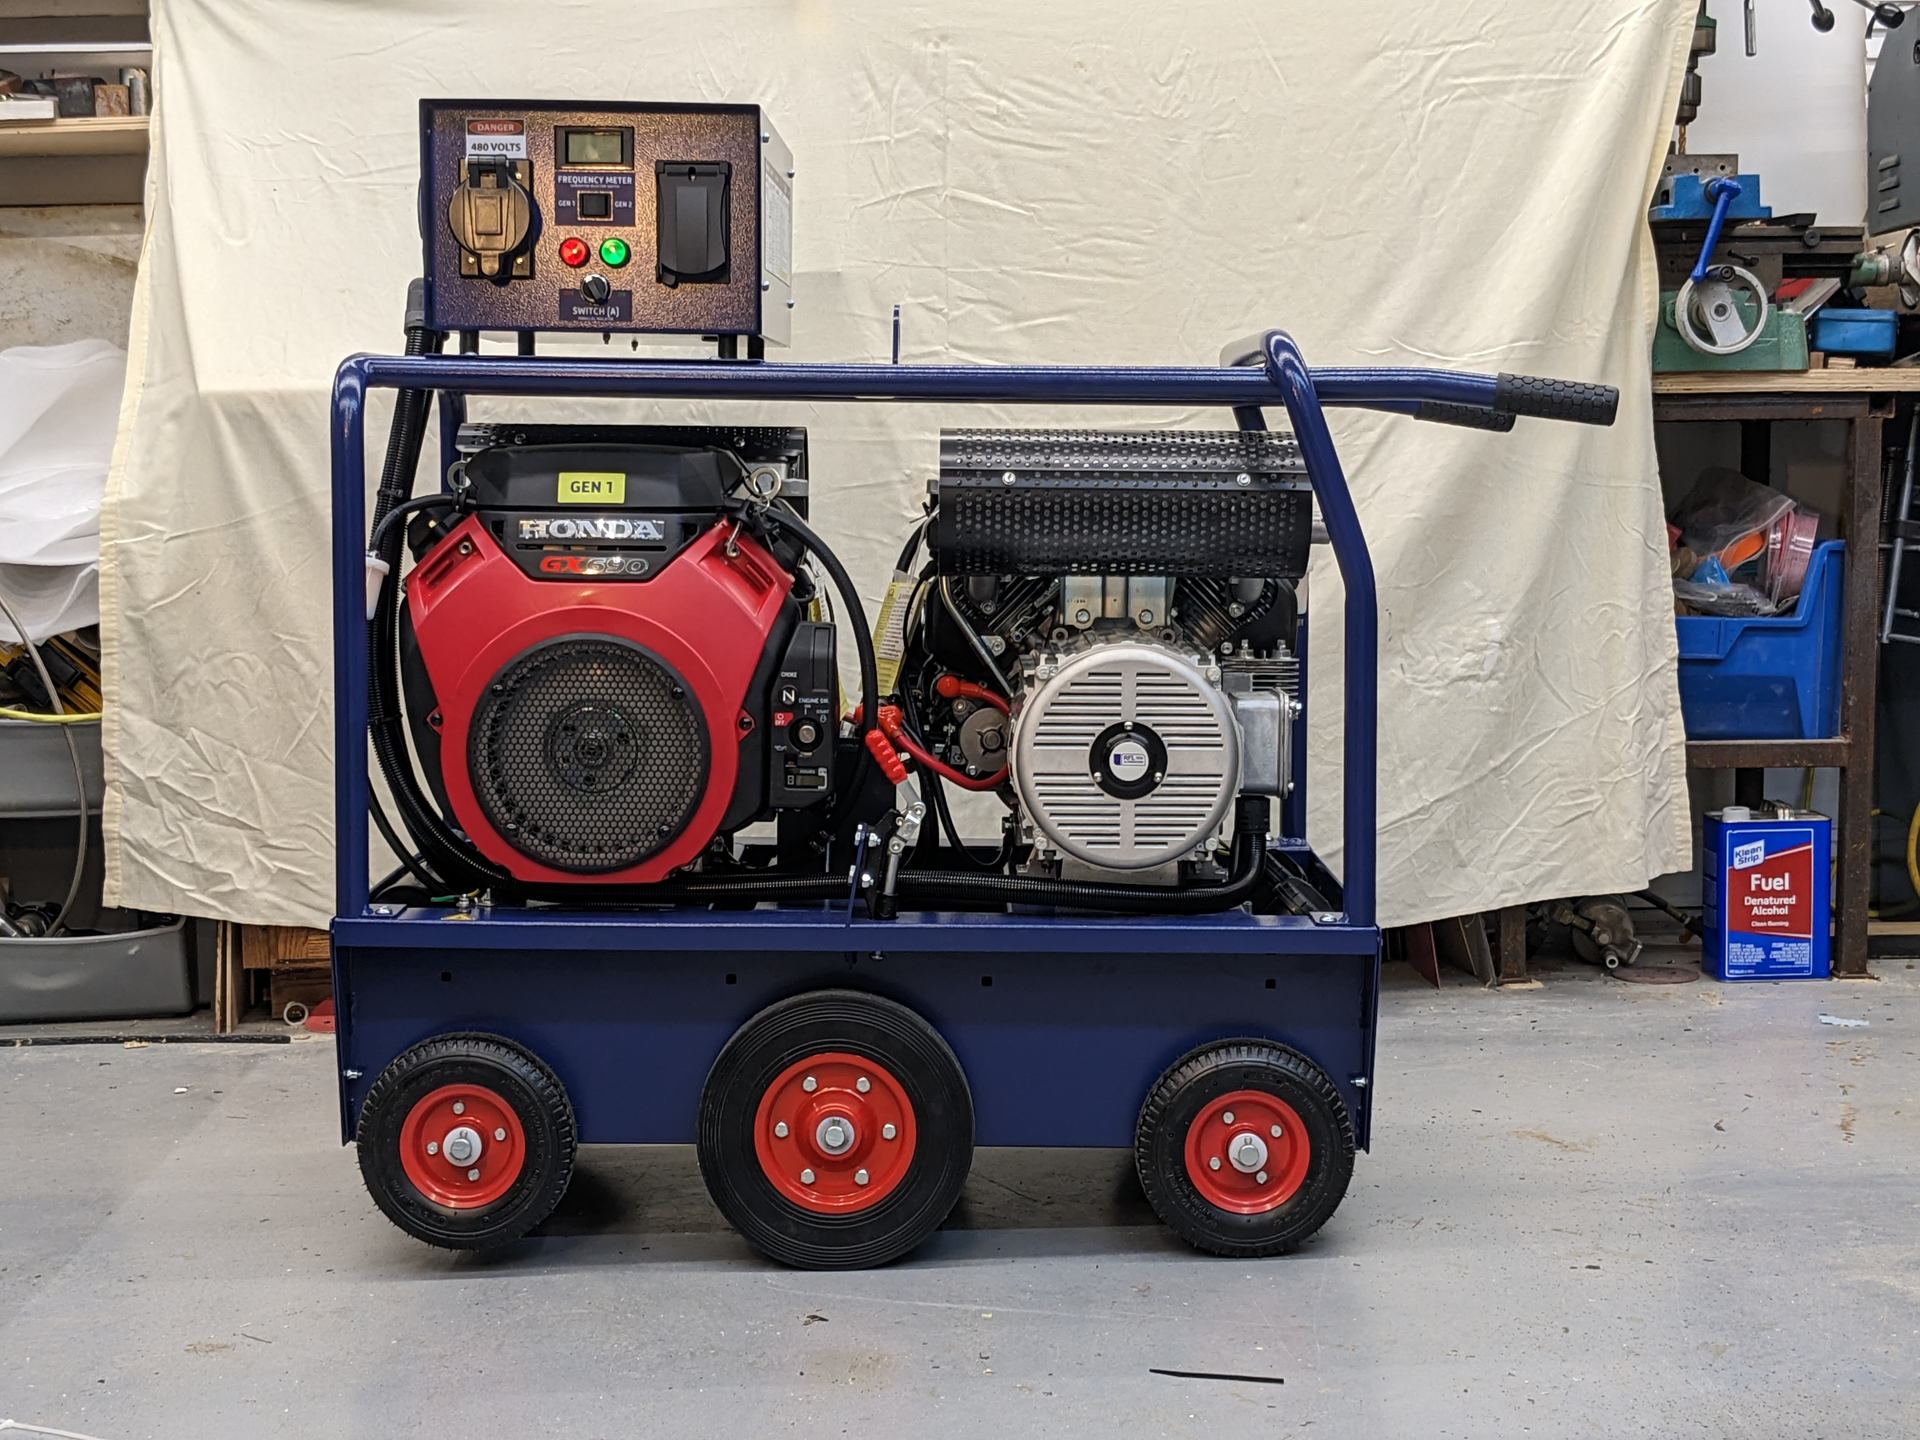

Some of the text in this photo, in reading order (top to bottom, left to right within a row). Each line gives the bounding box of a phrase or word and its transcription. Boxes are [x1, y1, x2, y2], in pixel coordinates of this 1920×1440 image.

[477, 123, 515, 132] DANGER
[471, 142, 522, 152] 480 VOLTS
[557, 175, 633, 185] FREQUENCY METER
[558, 199, 571, 207] GEN
[614, 200, 633, 208] GEN 2
[572, 306, 620, 318] SWITCH (A)
[570, 480, 614, 494] GEN 1
[518, 518, 666, 541] HONDA
[540, 556, 650, 575] GX690
[1735, 846, 1762, 858] Klean
[1738, 854, 1759, 865] Strip
[1750, 872, 1790, 891] Fuel
[1744, 895, 1796, 906] Denatured
[1751, 905, 1788, 916] Alcohol
